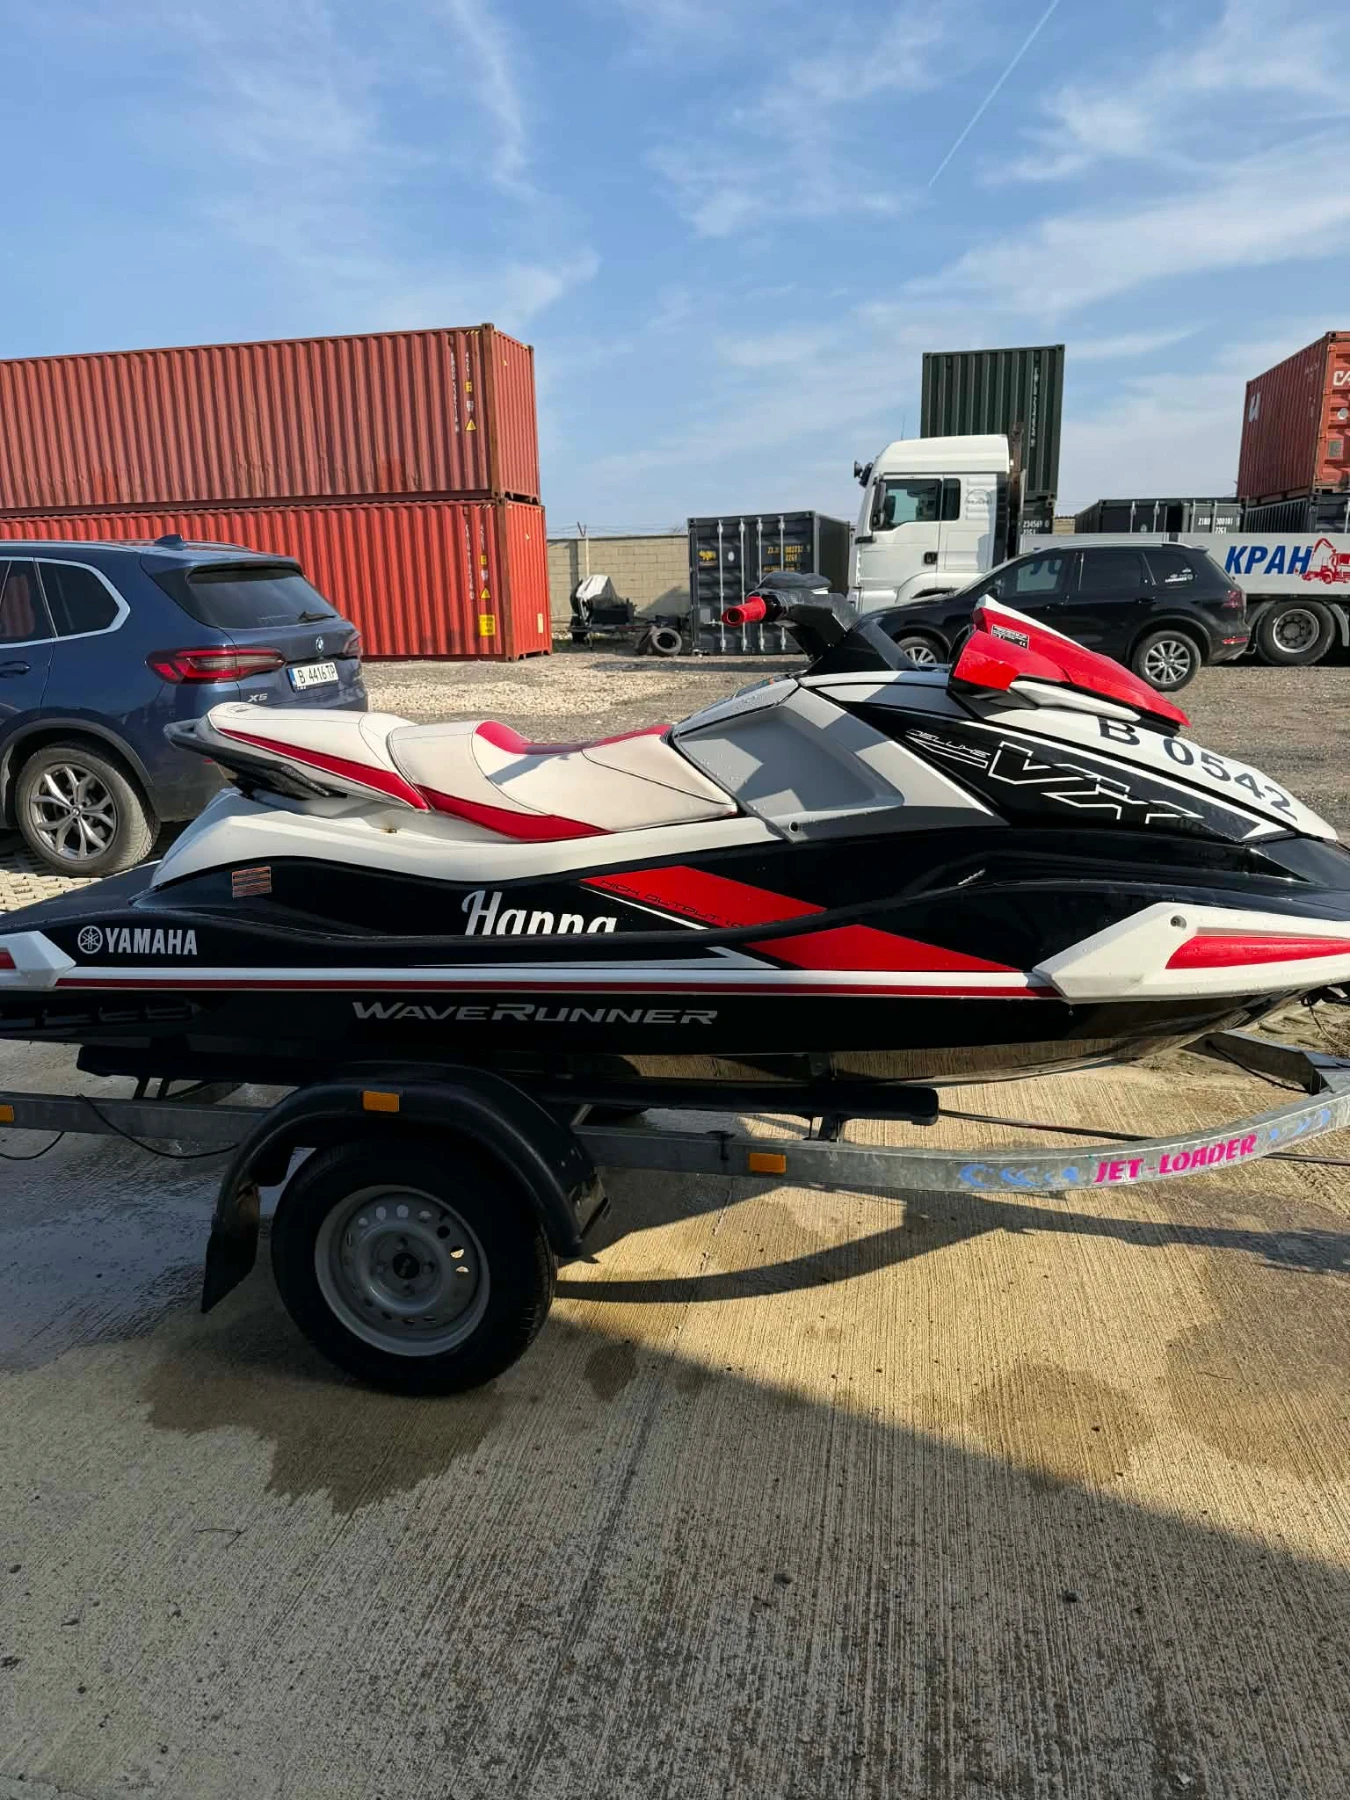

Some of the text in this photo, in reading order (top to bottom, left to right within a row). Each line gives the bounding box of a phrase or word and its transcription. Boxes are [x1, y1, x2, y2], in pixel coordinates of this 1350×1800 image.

[1225, 545, 1314, 575] КРАН
[247, 693, 268, 703] X5
[1097, 716, 1298, 822] B 0542
[645, 893, 719, 920] OUTPUT
[105, 927, 198, 955] YAMAHA
